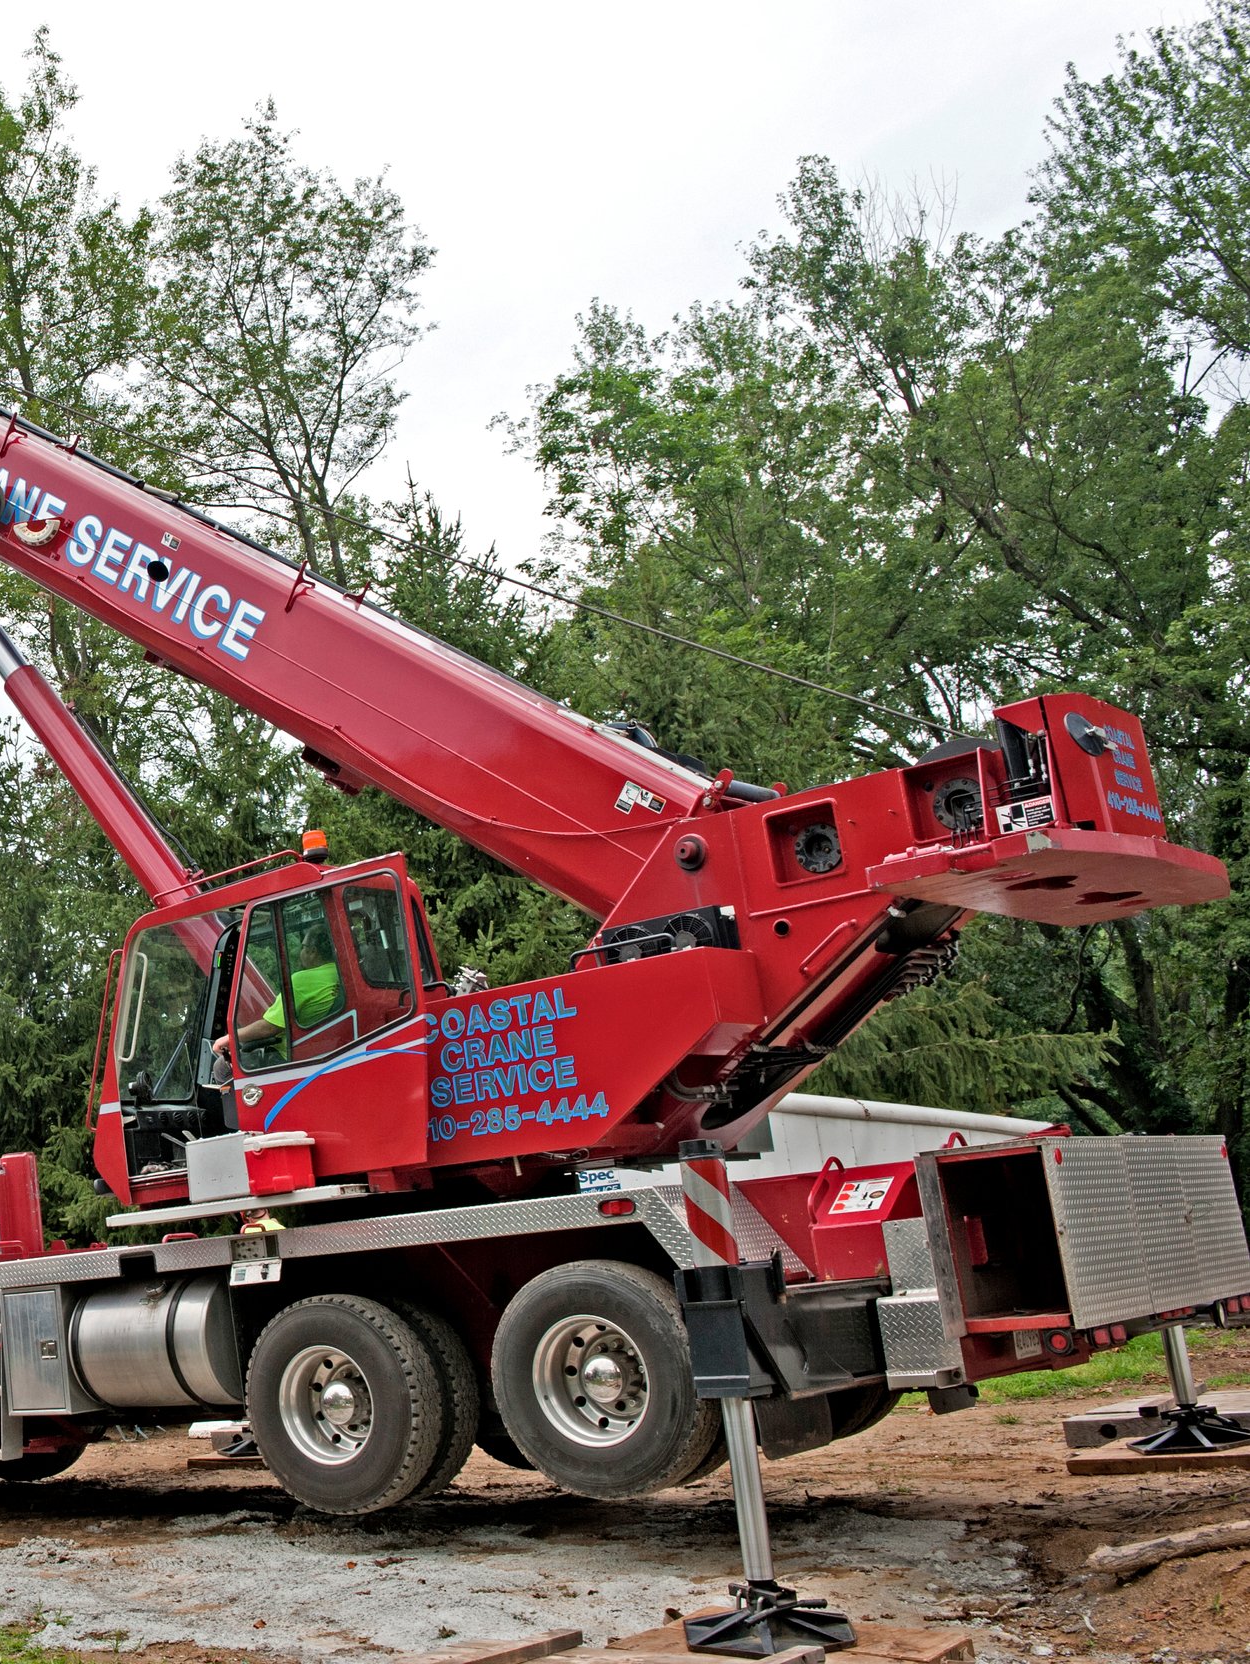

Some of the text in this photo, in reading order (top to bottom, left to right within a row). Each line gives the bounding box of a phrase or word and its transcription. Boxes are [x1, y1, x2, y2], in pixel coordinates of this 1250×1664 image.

[66, 515, 266, 662] SERVICE
[425, 988, 577, 1044] COASTAL
[440, 1024, 557, 1073] CRANE
[430, 1055, 578, 1108] SERVICE
[426, 1091, 609, 1142] 10-285-4444
